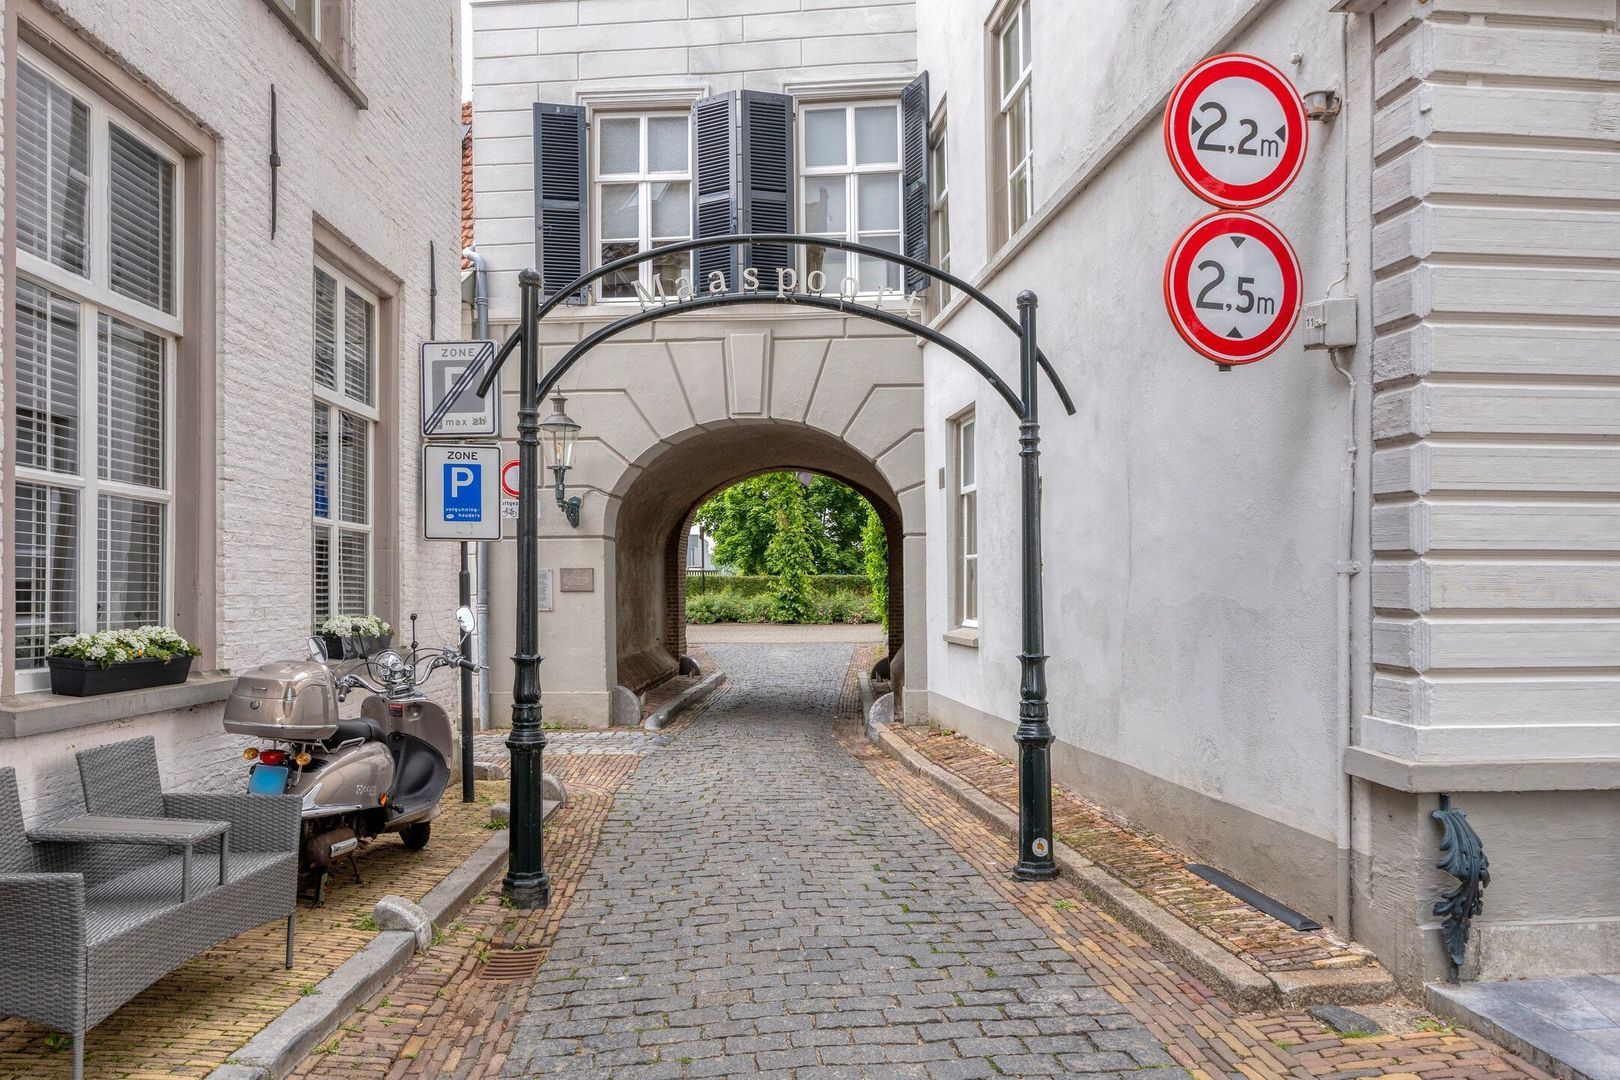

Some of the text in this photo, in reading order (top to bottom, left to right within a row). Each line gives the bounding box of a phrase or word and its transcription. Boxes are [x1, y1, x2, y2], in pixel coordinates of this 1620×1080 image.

[1196, 101, 1279, 158] 2,2m
[631, 267, 921, 317] Maaspoort
[1195, 259, 1275, 315] 2,5m
[441, 348, 475, 357] ZONE
[445, 419, 468, 427] max
[447, 451, 478, 460] ZONE
[451, 467, 474, 498] P
